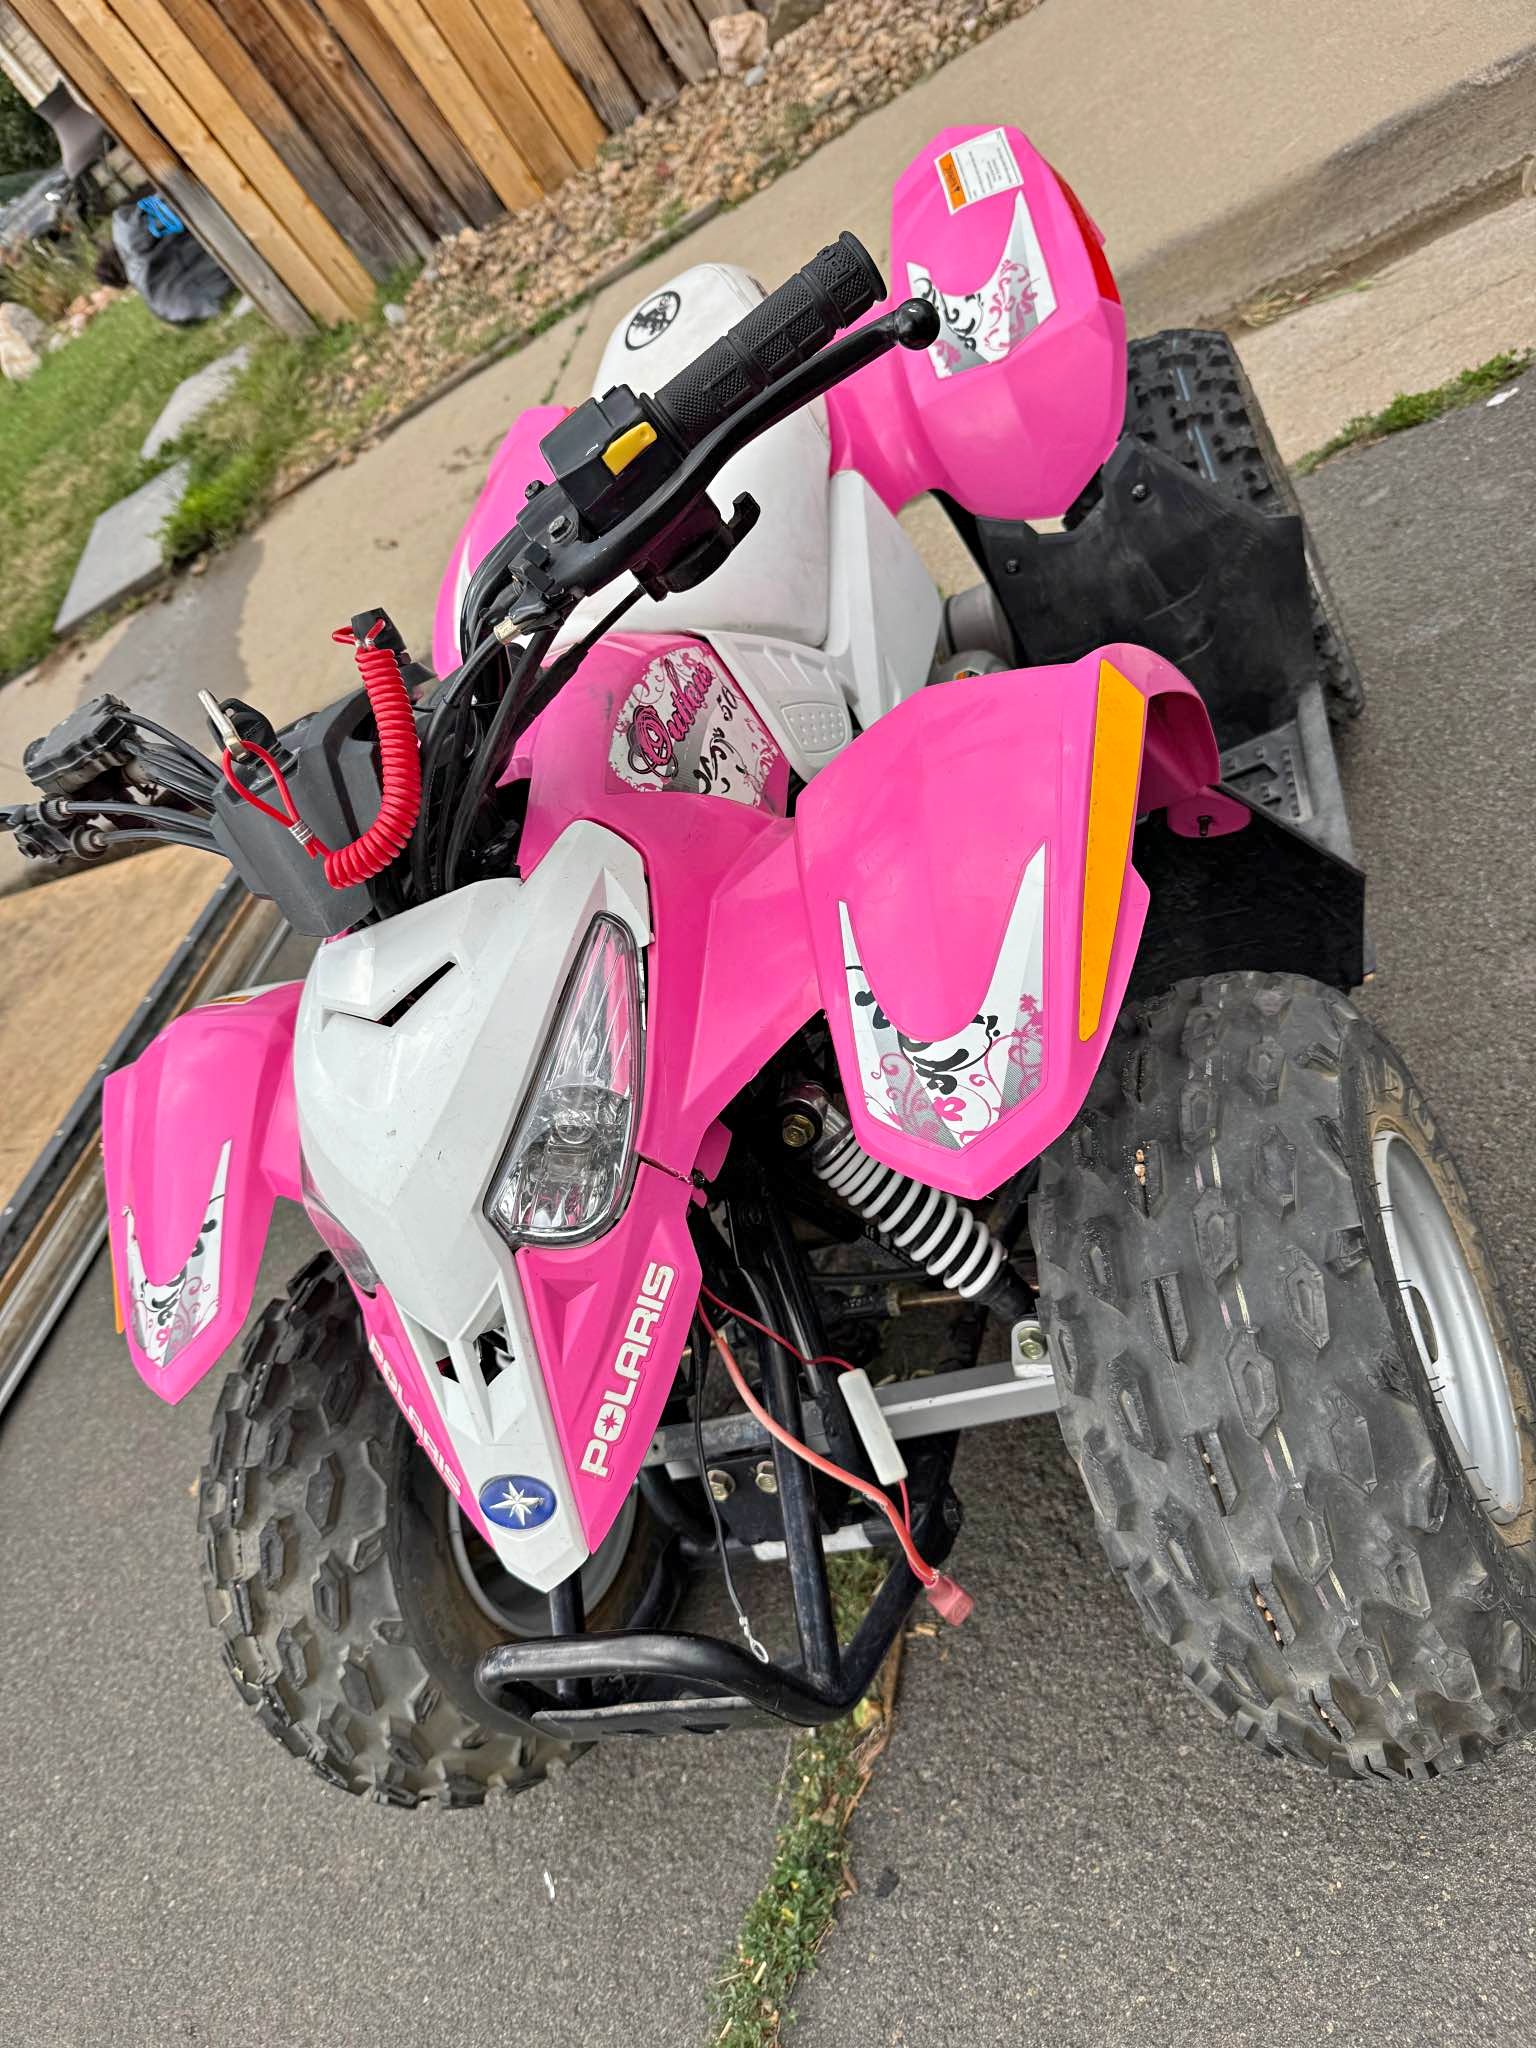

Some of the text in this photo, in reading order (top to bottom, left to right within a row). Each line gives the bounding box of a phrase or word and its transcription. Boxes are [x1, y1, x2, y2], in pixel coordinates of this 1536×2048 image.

[627, 658, 715, 777] Outlaw
[717, 686, 738, 721] 50
[368, 1332, 462, 1497] POLARIS
[580, 1262, 676, 1478] POLARIS
